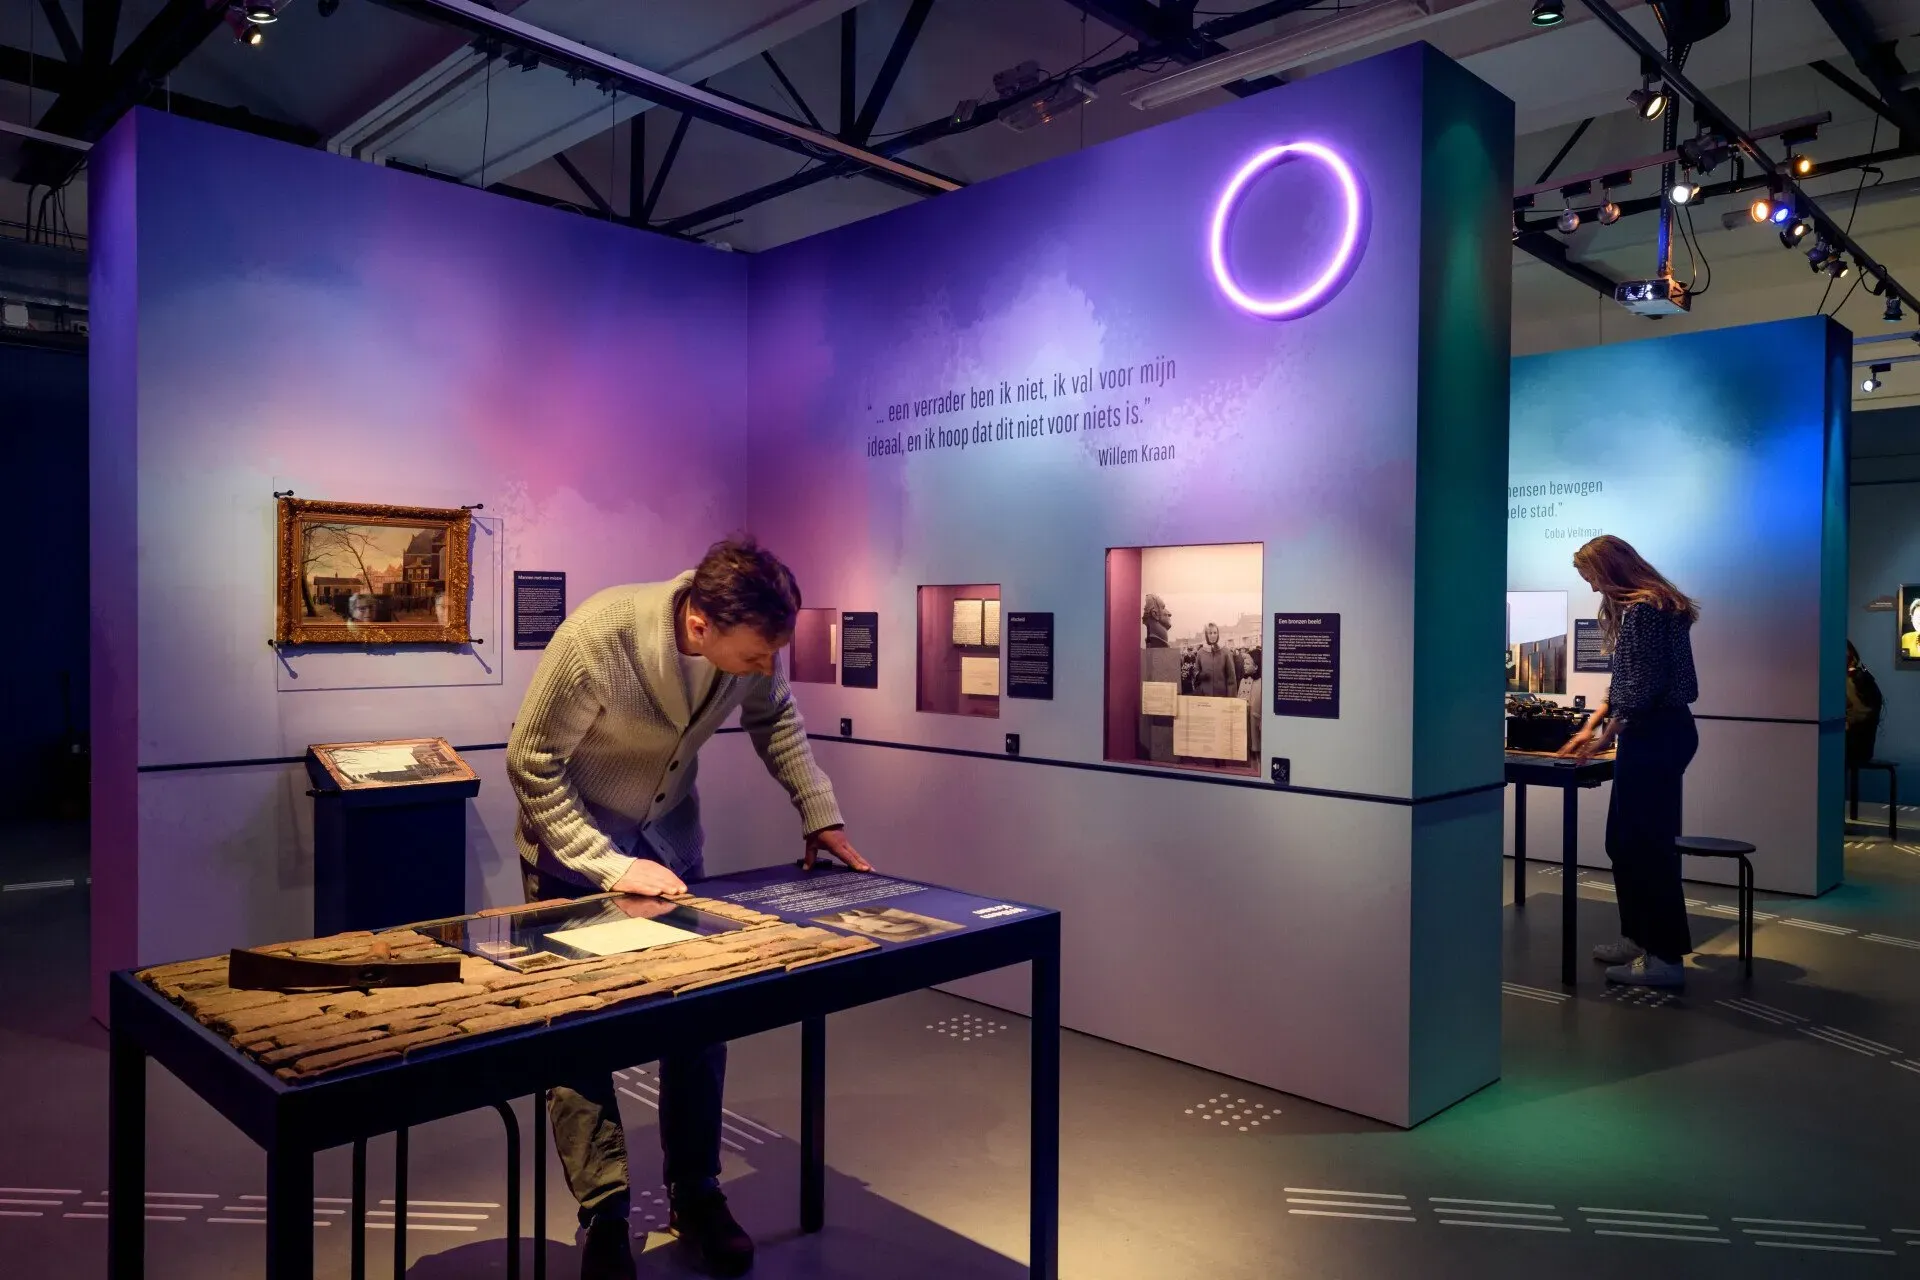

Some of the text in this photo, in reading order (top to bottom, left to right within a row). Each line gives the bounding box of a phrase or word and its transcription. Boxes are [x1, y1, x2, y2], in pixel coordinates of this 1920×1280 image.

[889, 402, 909, 422] een
[914, 390, 965, 418] verrader
[971, 386, 994, 409] ben
[1000, 380, 1011, 404] ik
[1017, 377, 1047, 401] niet,
[1053, 373, 1066, 397] ik
[1071, 368, 1093, 393] val
[1099, 366, 1134, 390] voor
[1140, 355, 1176, 387] mijn
[867, 434, 904, 457] ideaal,
[907, 432, 922, 452] en
[925, 427, 936, 450] ik
[938, 425, 969, 450] hoop
[972, 421, 993, 444] dat
[996, 416, 1013, 441] dit
[1017, 413, 1044, 438] niet
[1048, 411, 1079, 435] voor
[1083, 404, 1121, 431] niets
[1098, 443, 1175, 467] Willem Kraan
[1549, 480, 1603, 497] bewogen
[1507, 503, 1527, 519] ele
[1545, 526, 1603, 539] Coba Veltman
